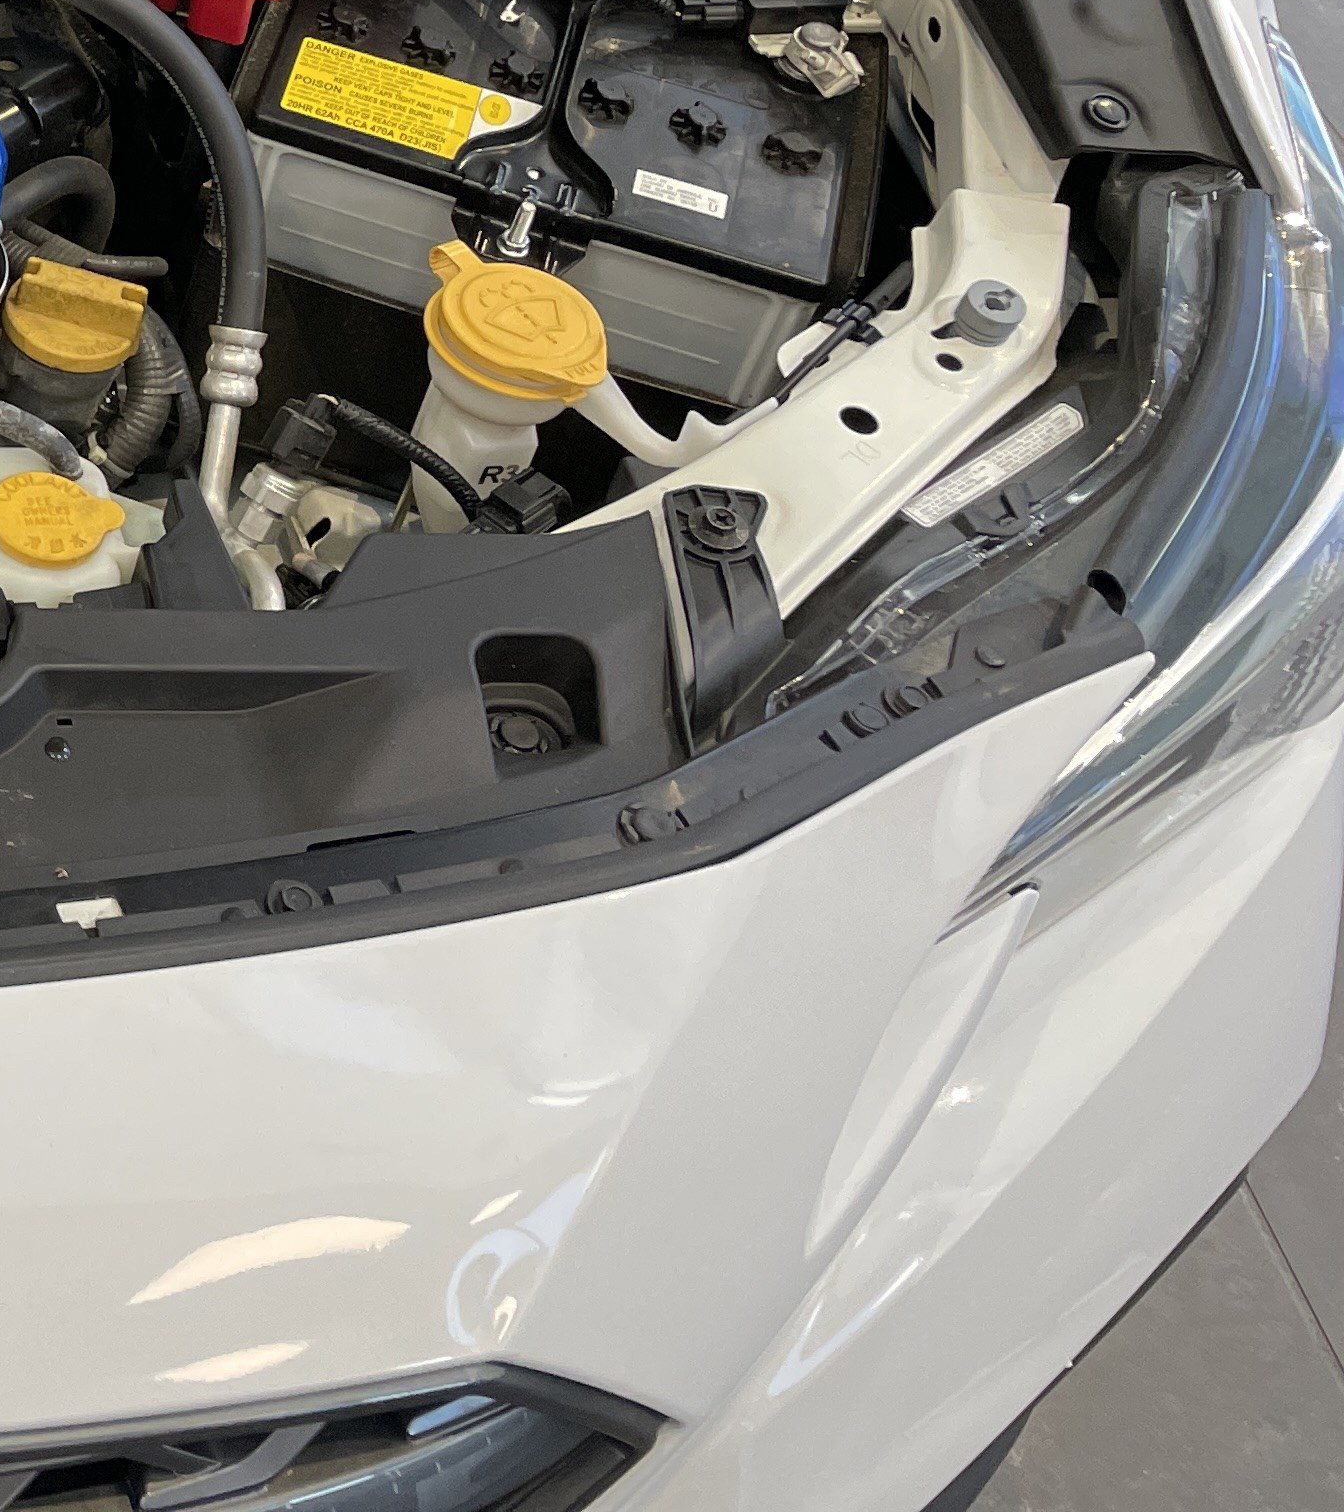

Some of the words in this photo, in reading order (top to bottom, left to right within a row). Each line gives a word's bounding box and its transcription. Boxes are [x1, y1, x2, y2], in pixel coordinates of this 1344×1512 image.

[305, 41, 356, 61] DANGER
[359, 56, 398, 72] EXPLOSIVE
[399, 68, 424, 80] GASES
[286, 99, 314, 114] 20HR
[314, 107, 341, 122] 62Ah
[344, 116, 369, 132] CCA
[293, 73, 343, 94] POISON
[348, 90, 378, 104] CAUSES
[378, 99, 408, 113] SEVERE
[408, 108, 434, 120] BURNS
[333, 76, 353, 86] KEEP
[353, 82, 373, 93] VENT
[373, 88, 394, 98] CAPS
[394, 93, 416, 104] TIGHT
[416, 100, 432, 111] AND
[432, 105, 455, 118] LEVEL
[323, 101, 344, 112] KEEP
[344, 107, 361, 117] OUT
[372, 115, 398, 128] REACH
[409, 126, 447, 144] CHILDREN
